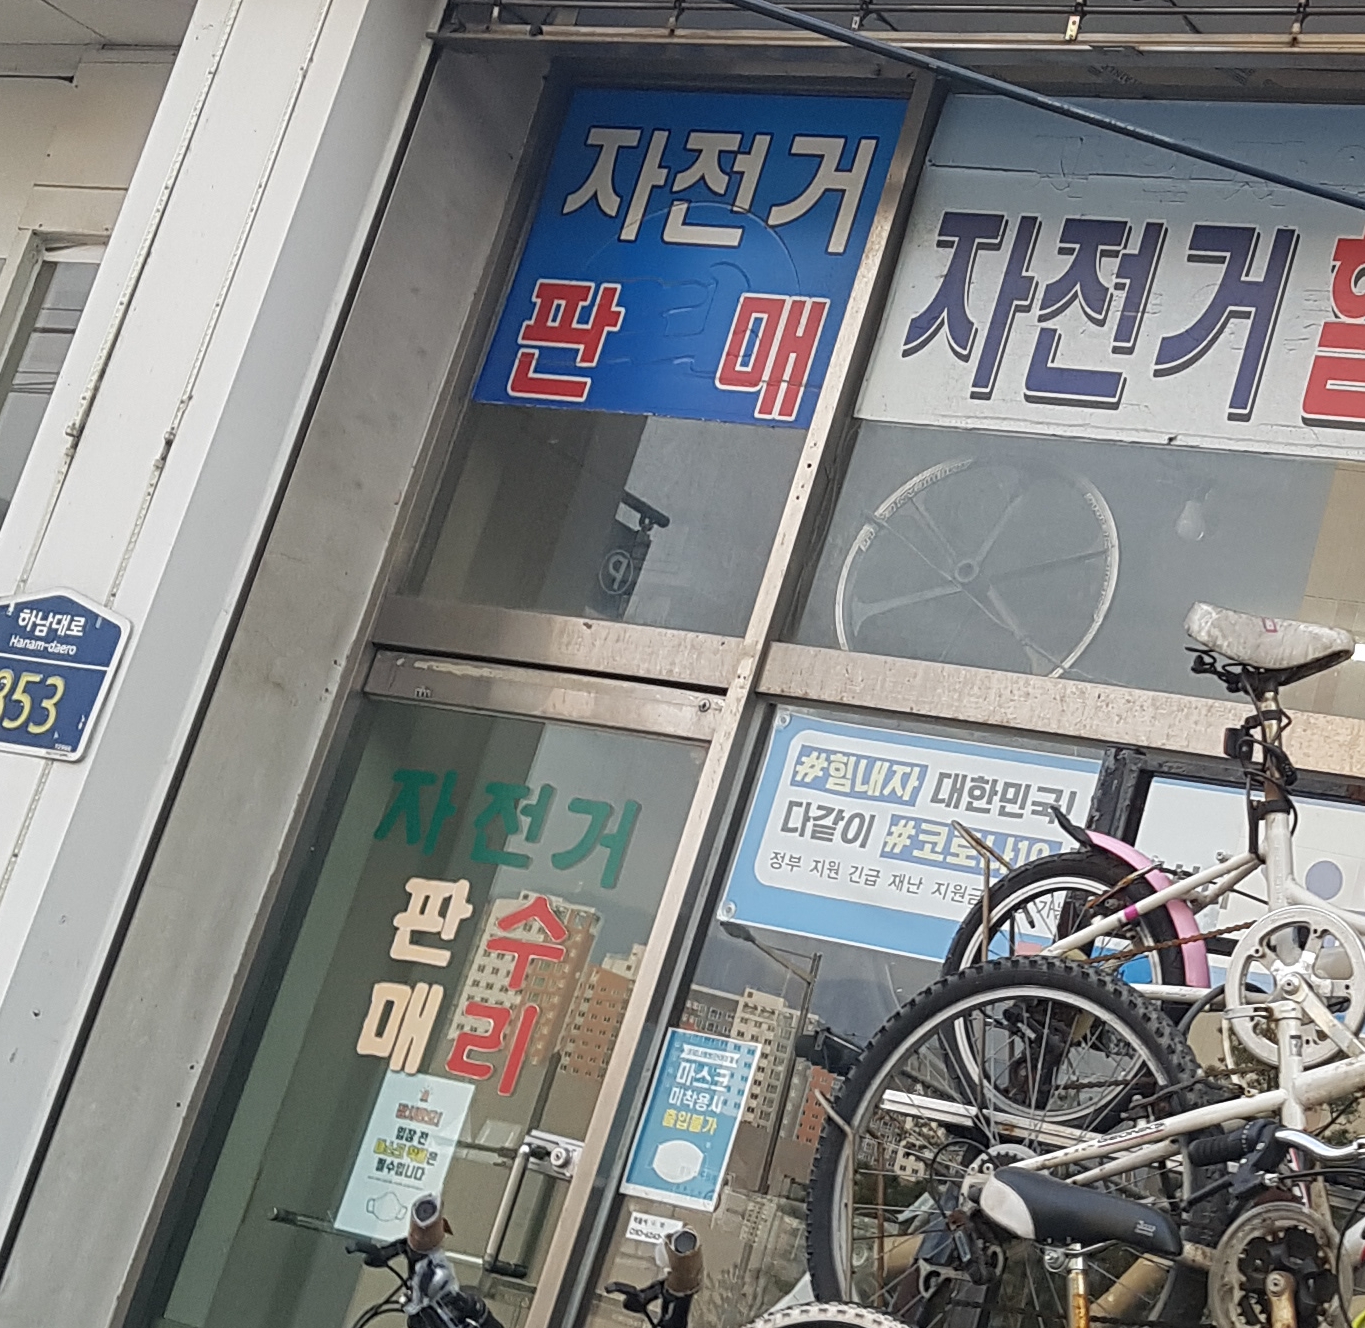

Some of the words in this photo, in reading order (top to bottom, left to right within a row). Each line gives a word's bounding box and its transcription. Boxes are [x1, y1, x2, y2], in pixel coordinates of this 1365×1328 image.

[561, 125, 879, 256] 자전거
[9, 634, 77, 656] Hanam-daero
[18, 608, 86, 637] 하남대로
[794, 748, 921, 802] #힘내자
[929, 771, 1079, 824] 대한민국!
[374, 767, 643, 889] 자전거
[780, 799, 876, 849] 다같이
[769, 850, 802, 872] 정부
[809, 858, 842, 881] 지원
[848, 864, 881, 886] 긴급
[888, 873, 924, 895] 재난
[676, 1061, 731, 1092] 마스크
[668, 1086, 724, 1114] 미착용시
